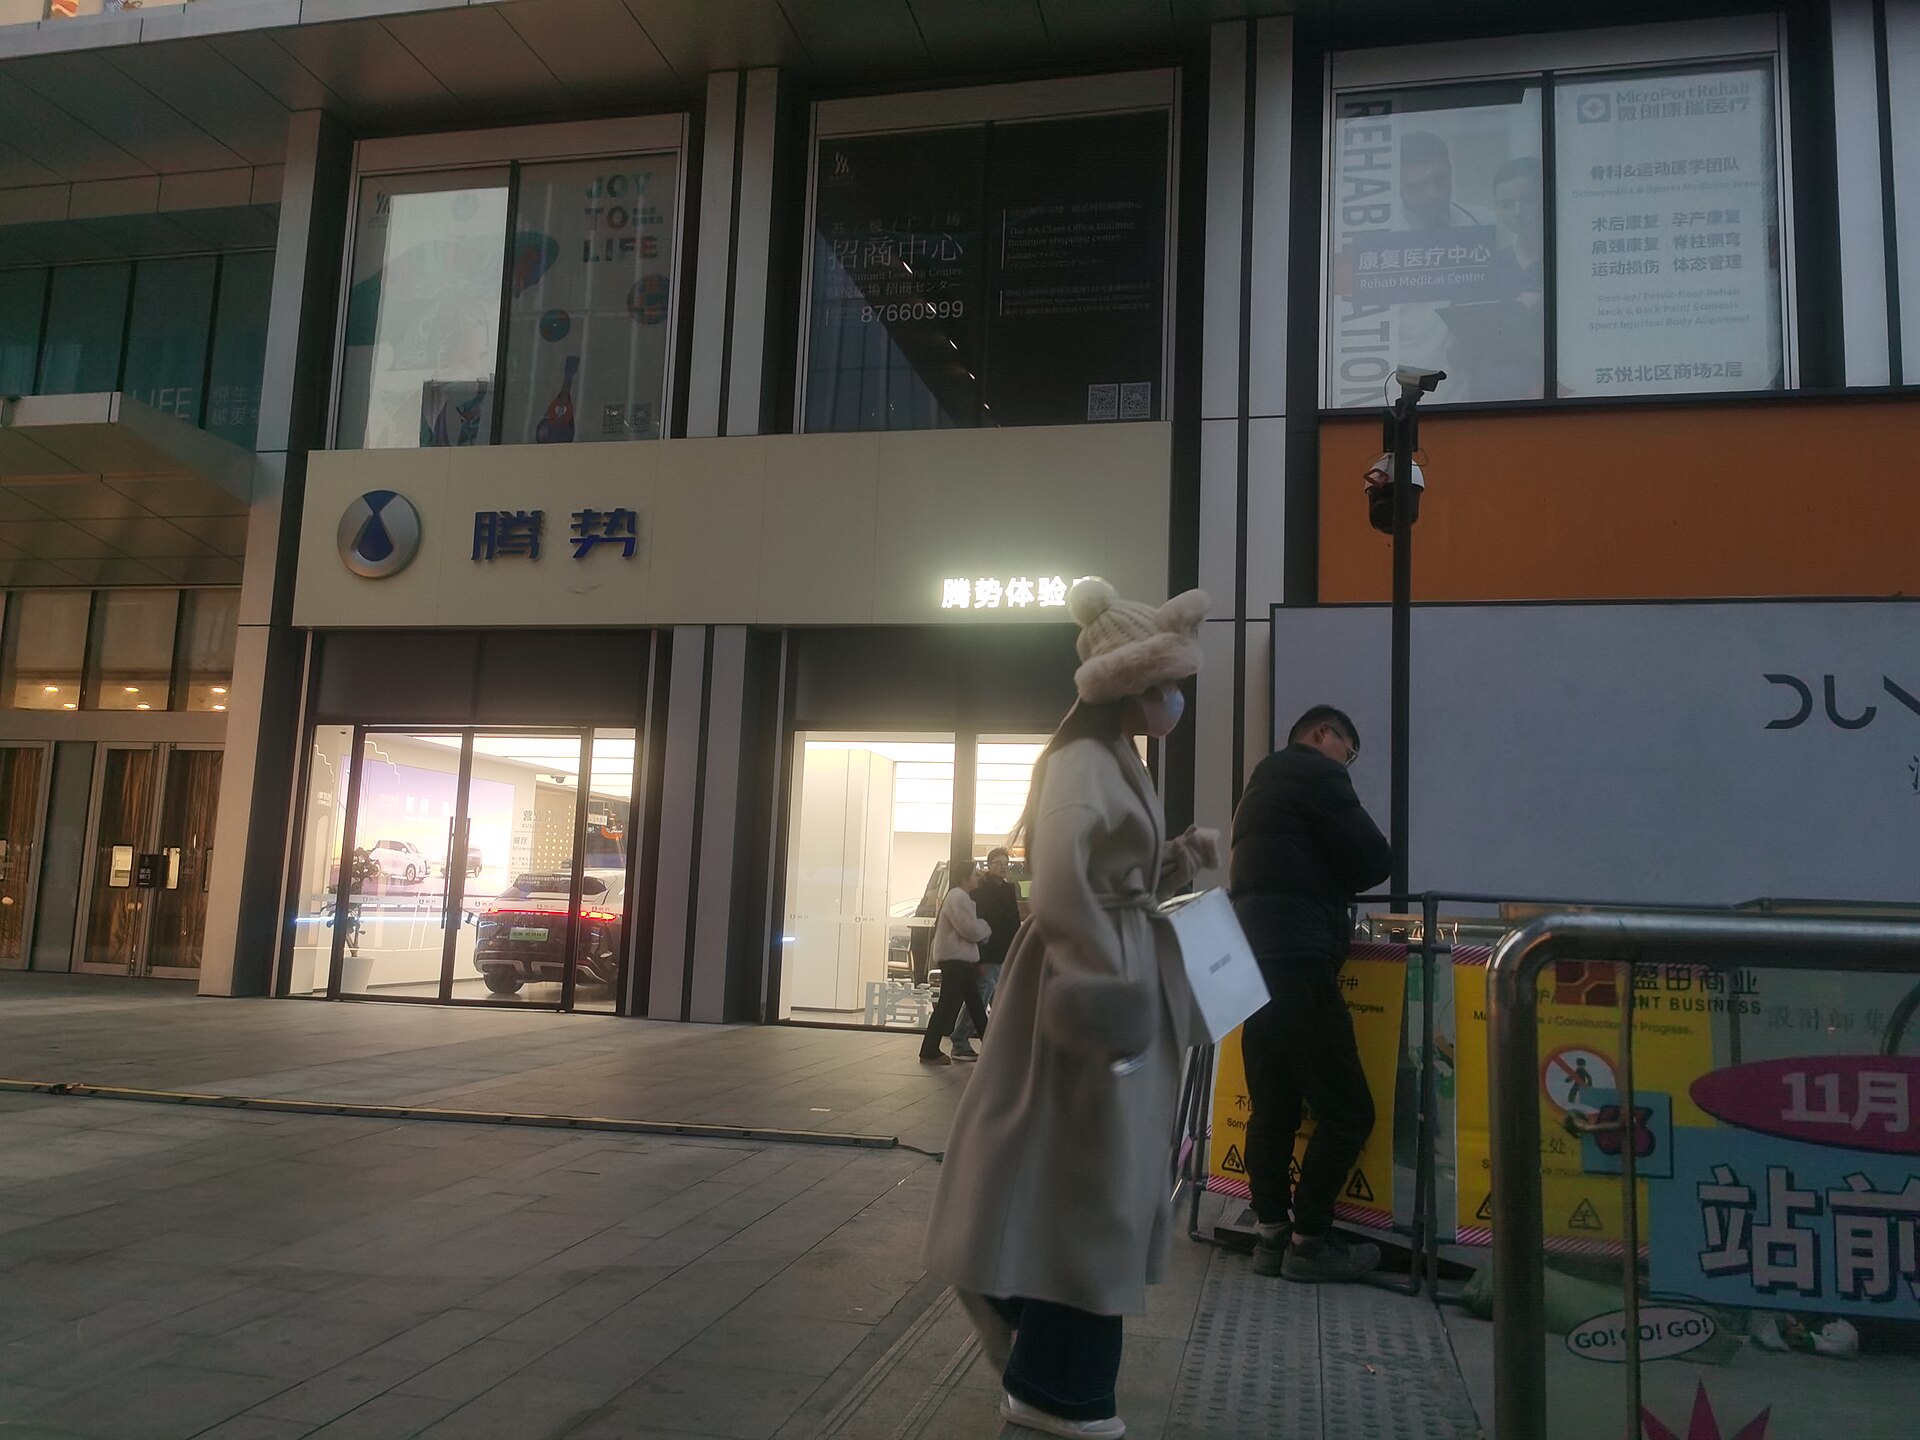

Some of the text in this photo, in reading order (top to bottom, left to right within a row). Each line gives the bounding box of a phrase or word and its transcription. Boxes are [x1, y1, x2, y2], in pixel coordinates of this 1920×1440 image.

[586, 172, 653, 199] JOY
[584, 206, 630, 230] TO
[583, 236, 659, 263] LIFE
[828, 232, 964, 271] 招商中心
[1357, 243, 1492, 271] 康复医疗中心
[1591, 254, 1743, 277] 运动损伤 体态管理
[1360, 270, 1486, 290] Rehab Medical Center
[860, 300, 964, 323] 87660999
[1595, 361, 1744, 384] 苏悦北区商场2层
[471, 507, 639, 563] 腾势
[941, 575, 1084, 609] 腾势体验
[1669, 997, 1761, 1015] BUSINESS
[1780, 1071, 1910, 1133] 11月
[1574, 1328, 1617, 1349] GO!
[1667, 1317, 1710, 1338] GO!
